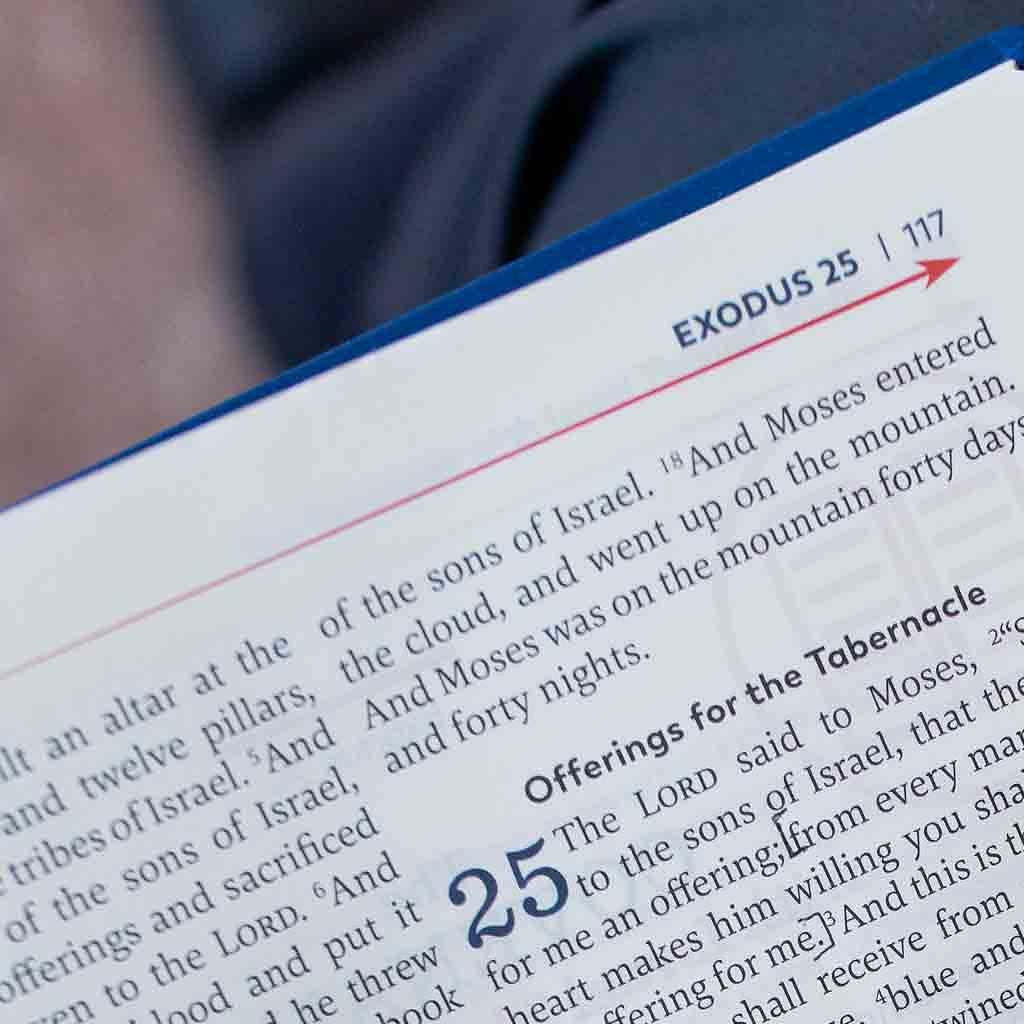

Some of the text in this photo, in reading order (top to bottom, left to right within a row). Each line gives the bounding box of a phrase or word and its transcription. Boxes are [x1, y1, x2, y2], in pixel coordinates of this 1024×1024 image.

[671, 208, 944, 349] EXODUS 25 117
[339, 375, 1016, 684] the cloud, and went up on the mountain.
[366, 673, 433, 730] And
[434, 635, 540, 695] Moses
[543, 605, 607, 646] was
[612, 585, 656, 617] on
[659, 558, 713, 595] the
[716, 487, 877, 570] mountain
[878, 448, 953, 498] forty
[3, 684, 316, 836] and twelve pillars,
[385, 643, 650, 774] and forty nights.
[524, 584, 987, 804] Offerings for the Tabernacle
[551, 653, 977, 852] The LORD said to Moses,
[151, 880, 216, 934] and
[223, 806, 380, 901] sacrificed
[576, 870, 610, 897] to
[619, 841, 674, 878] the
[683, 802, 756, 850] sons
[766, 771, 799, 811] of
[803, 730, 903, 794] Israel,
[910, 700, 977, 745] that
[247, 945, 311, 998] and
[323, 917, 383, 971] put
[391, 899, 423, 929] it
[448, 837, 569, 949] 25
[601, 930, 704, 992] makes
[706, 898, 779, 942] him
[784, 841, 900, 905] willing
[903, 811, 966, 862] you
[816, 931, 927, 995] receive
[936, 891, 1015, 940] from
